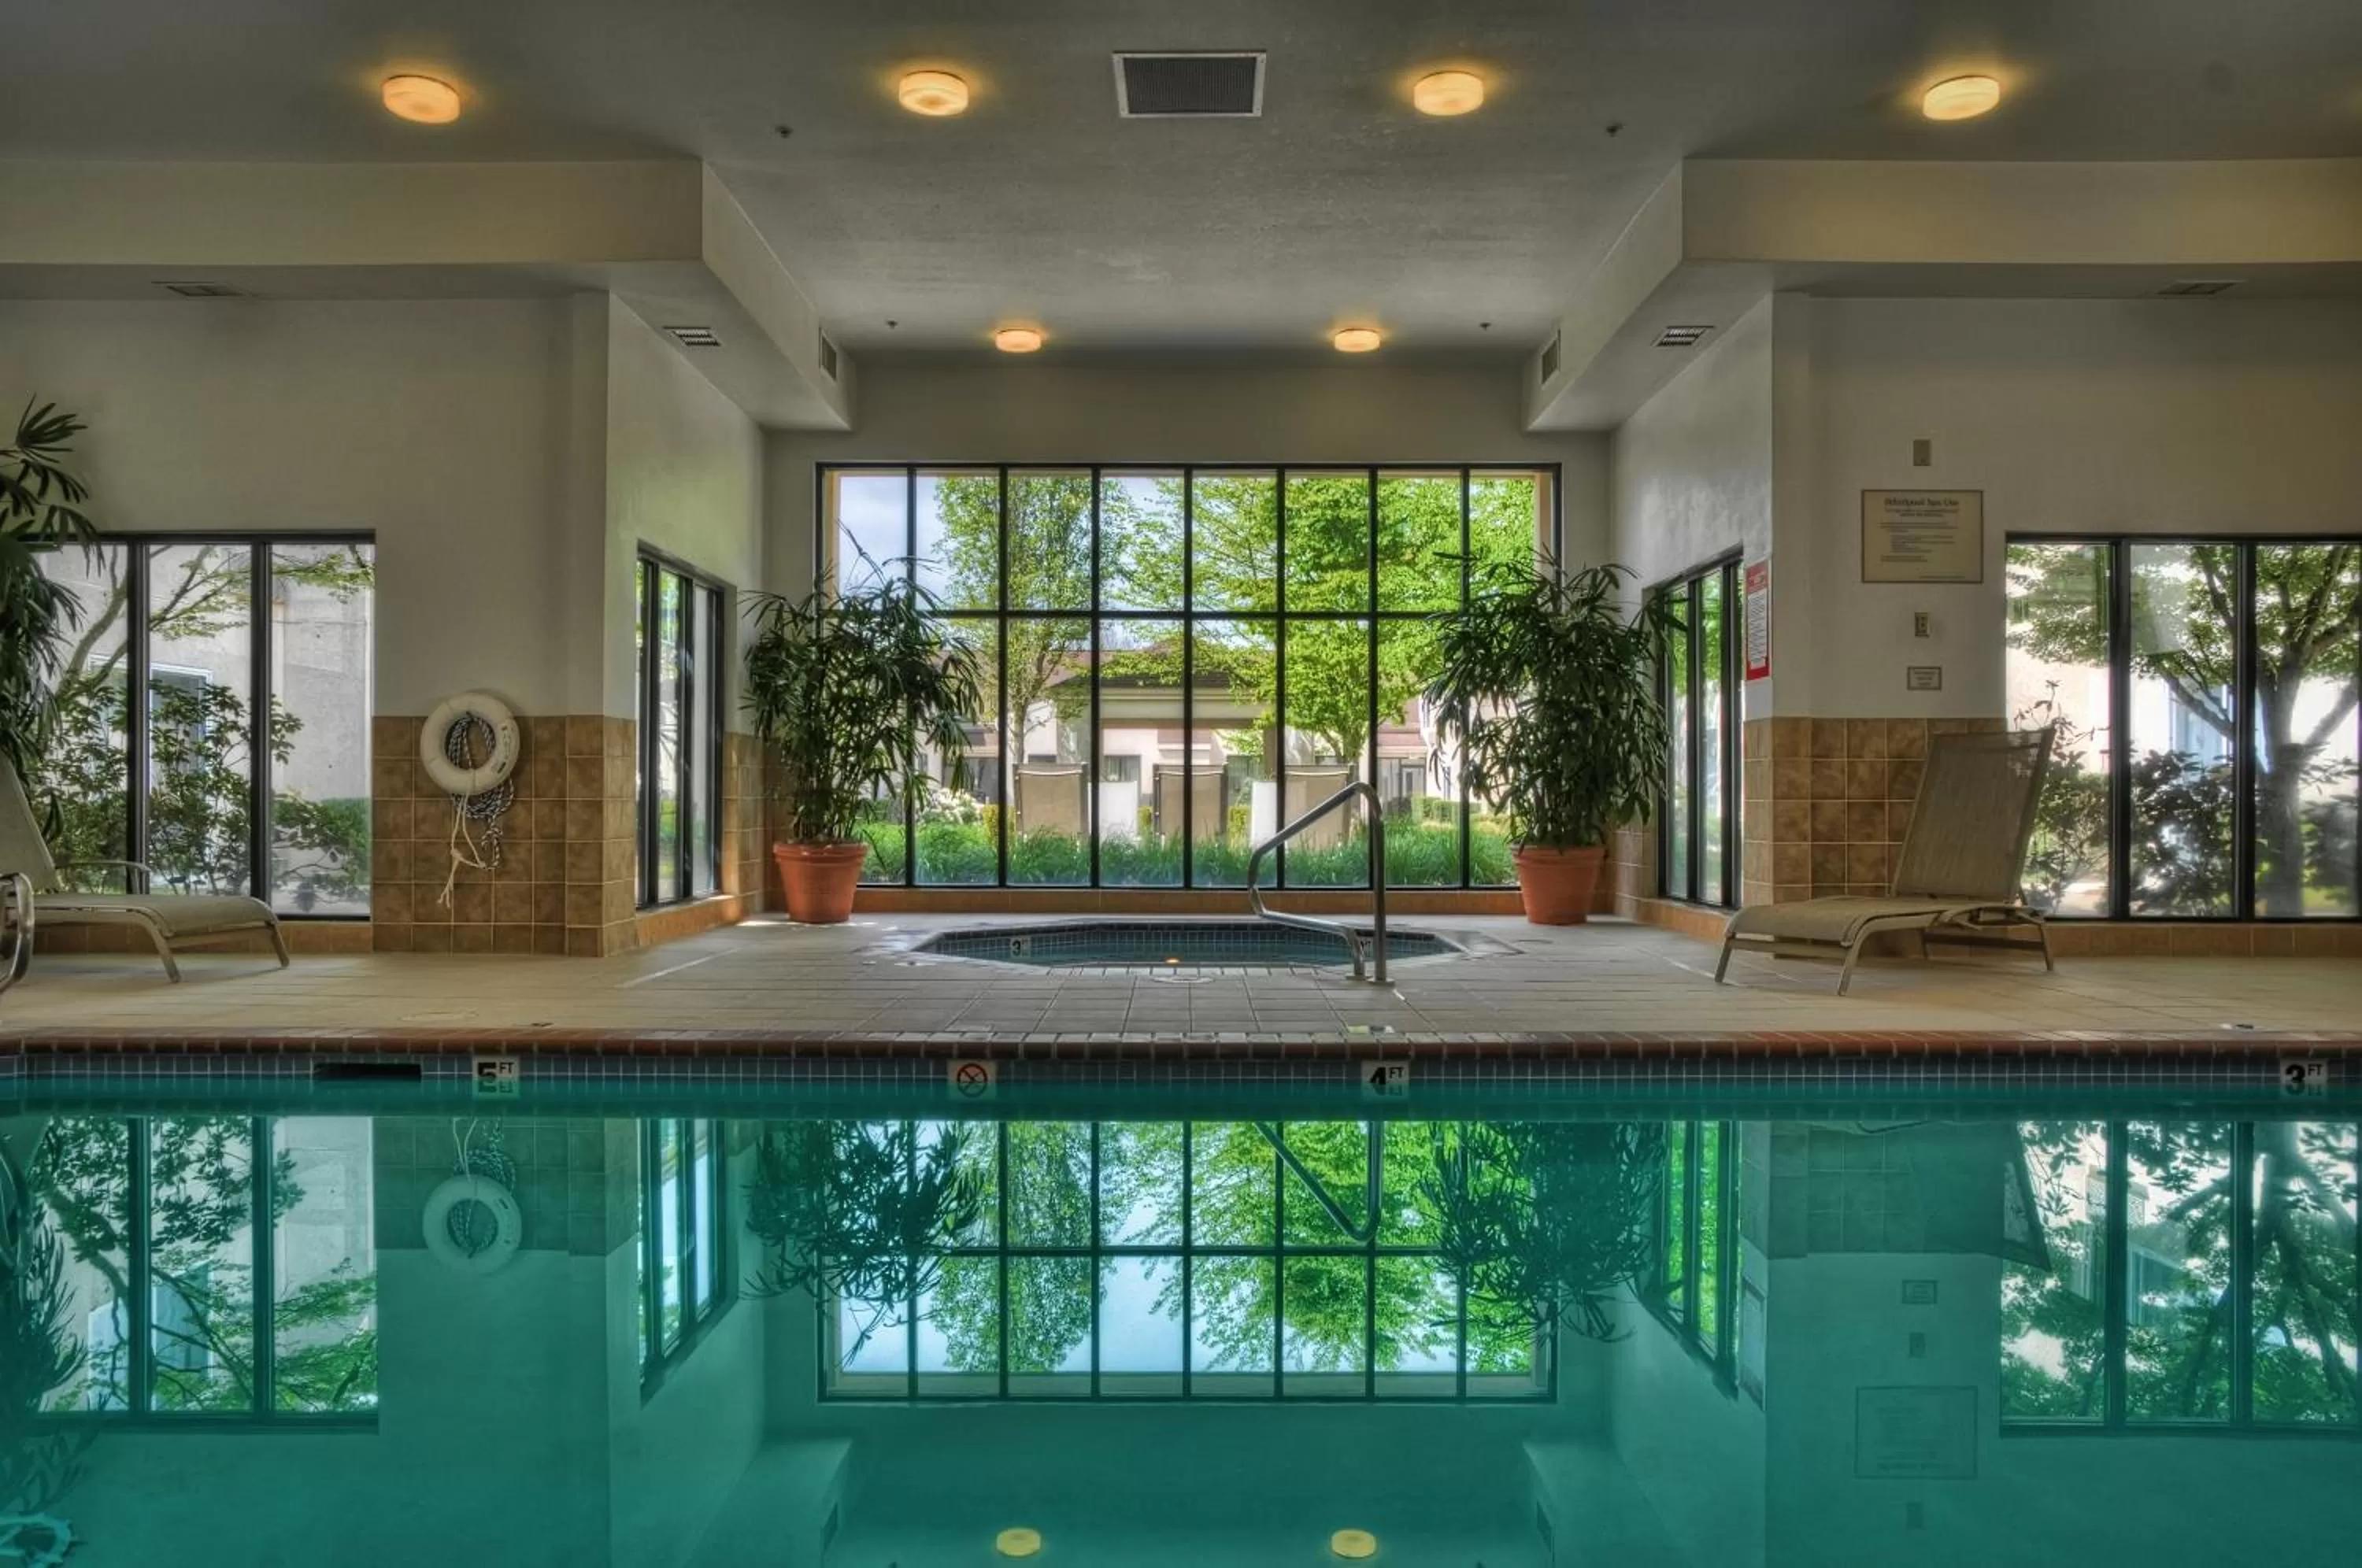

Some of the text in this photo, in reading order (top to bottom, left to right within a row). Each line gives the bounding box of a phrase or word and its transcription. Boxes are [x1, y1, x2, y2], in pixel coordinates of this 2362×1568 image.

[478, 1063, 513, 1085] 5 FT
[1369, 1067, 1404, 1085] 4 FT
[2308, 1064, 2323, 1076] FT
